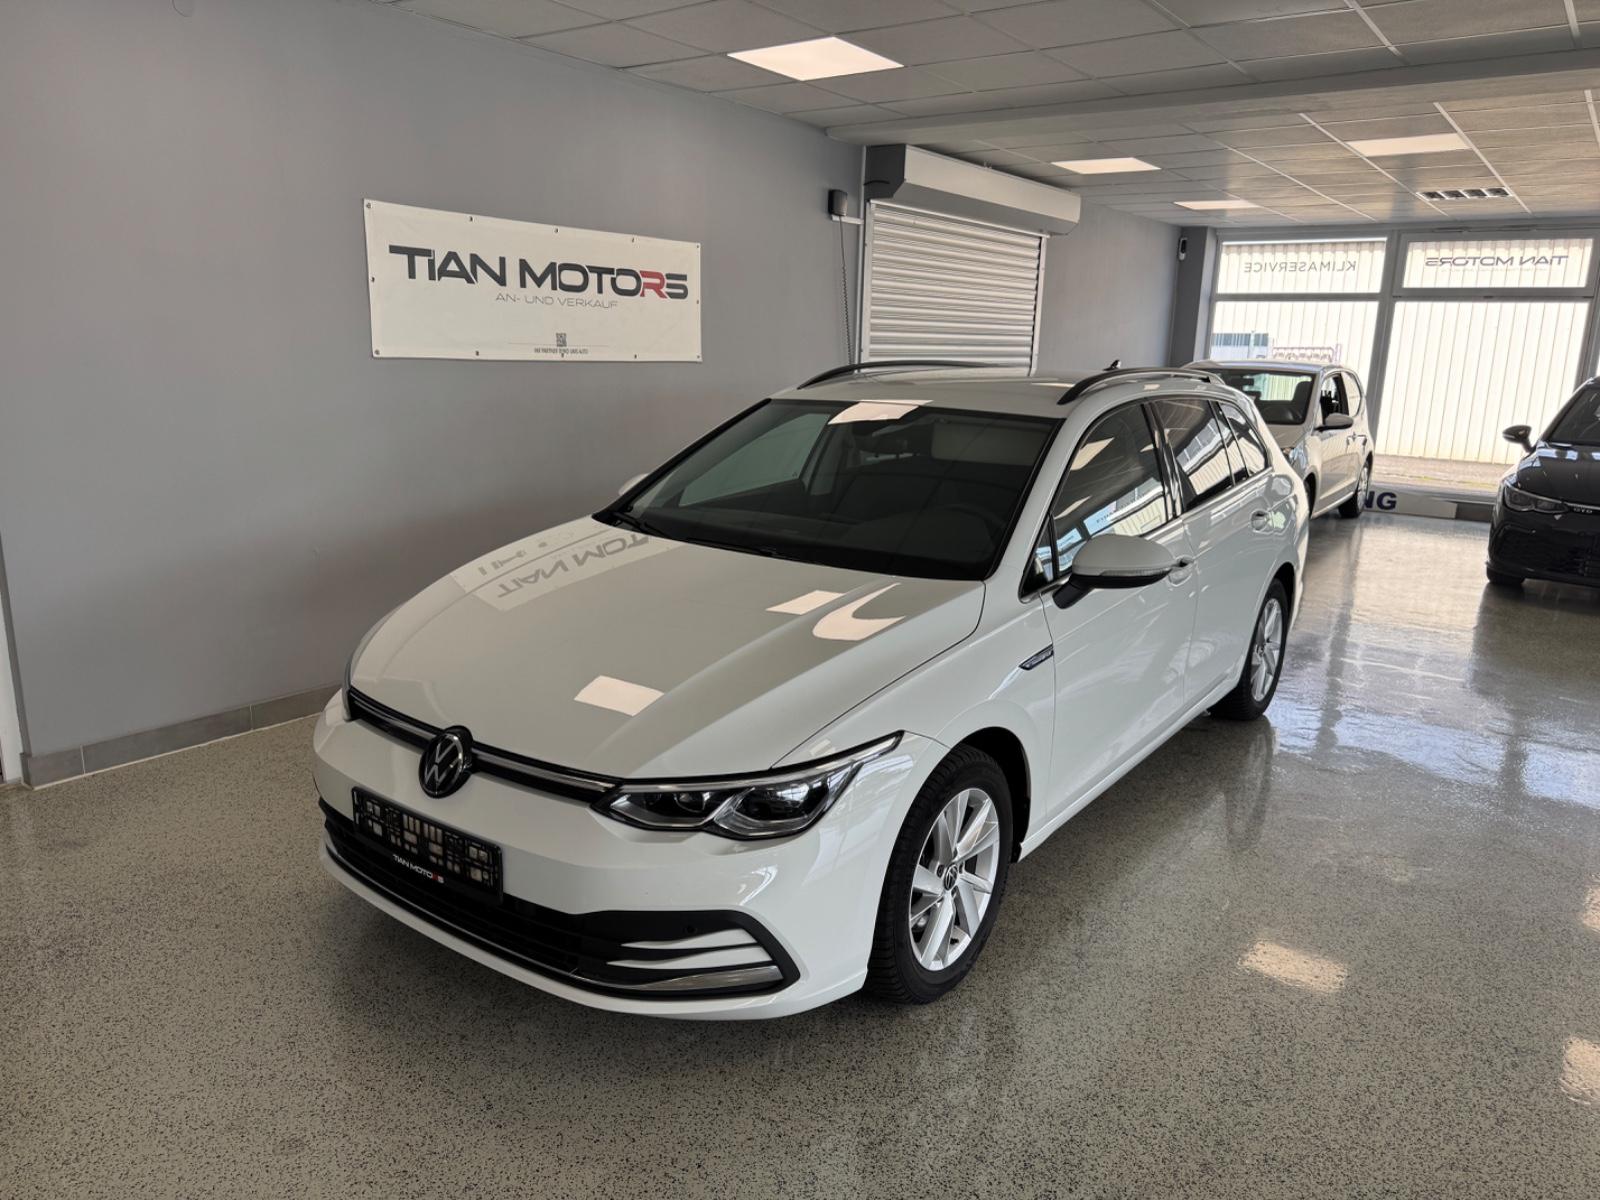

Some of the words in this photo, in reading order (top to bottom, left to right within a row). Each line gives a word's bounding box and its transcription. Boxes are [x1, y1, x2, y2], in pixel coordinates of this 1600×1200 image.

[389, 244, 507, 287] TIAN
[519, 258, 689, 300] MOTORS
[496, 292, 520, 302] AN-
[524, 294, 554, 306] UND
[557, 297, 618, 309] VERKAUF
